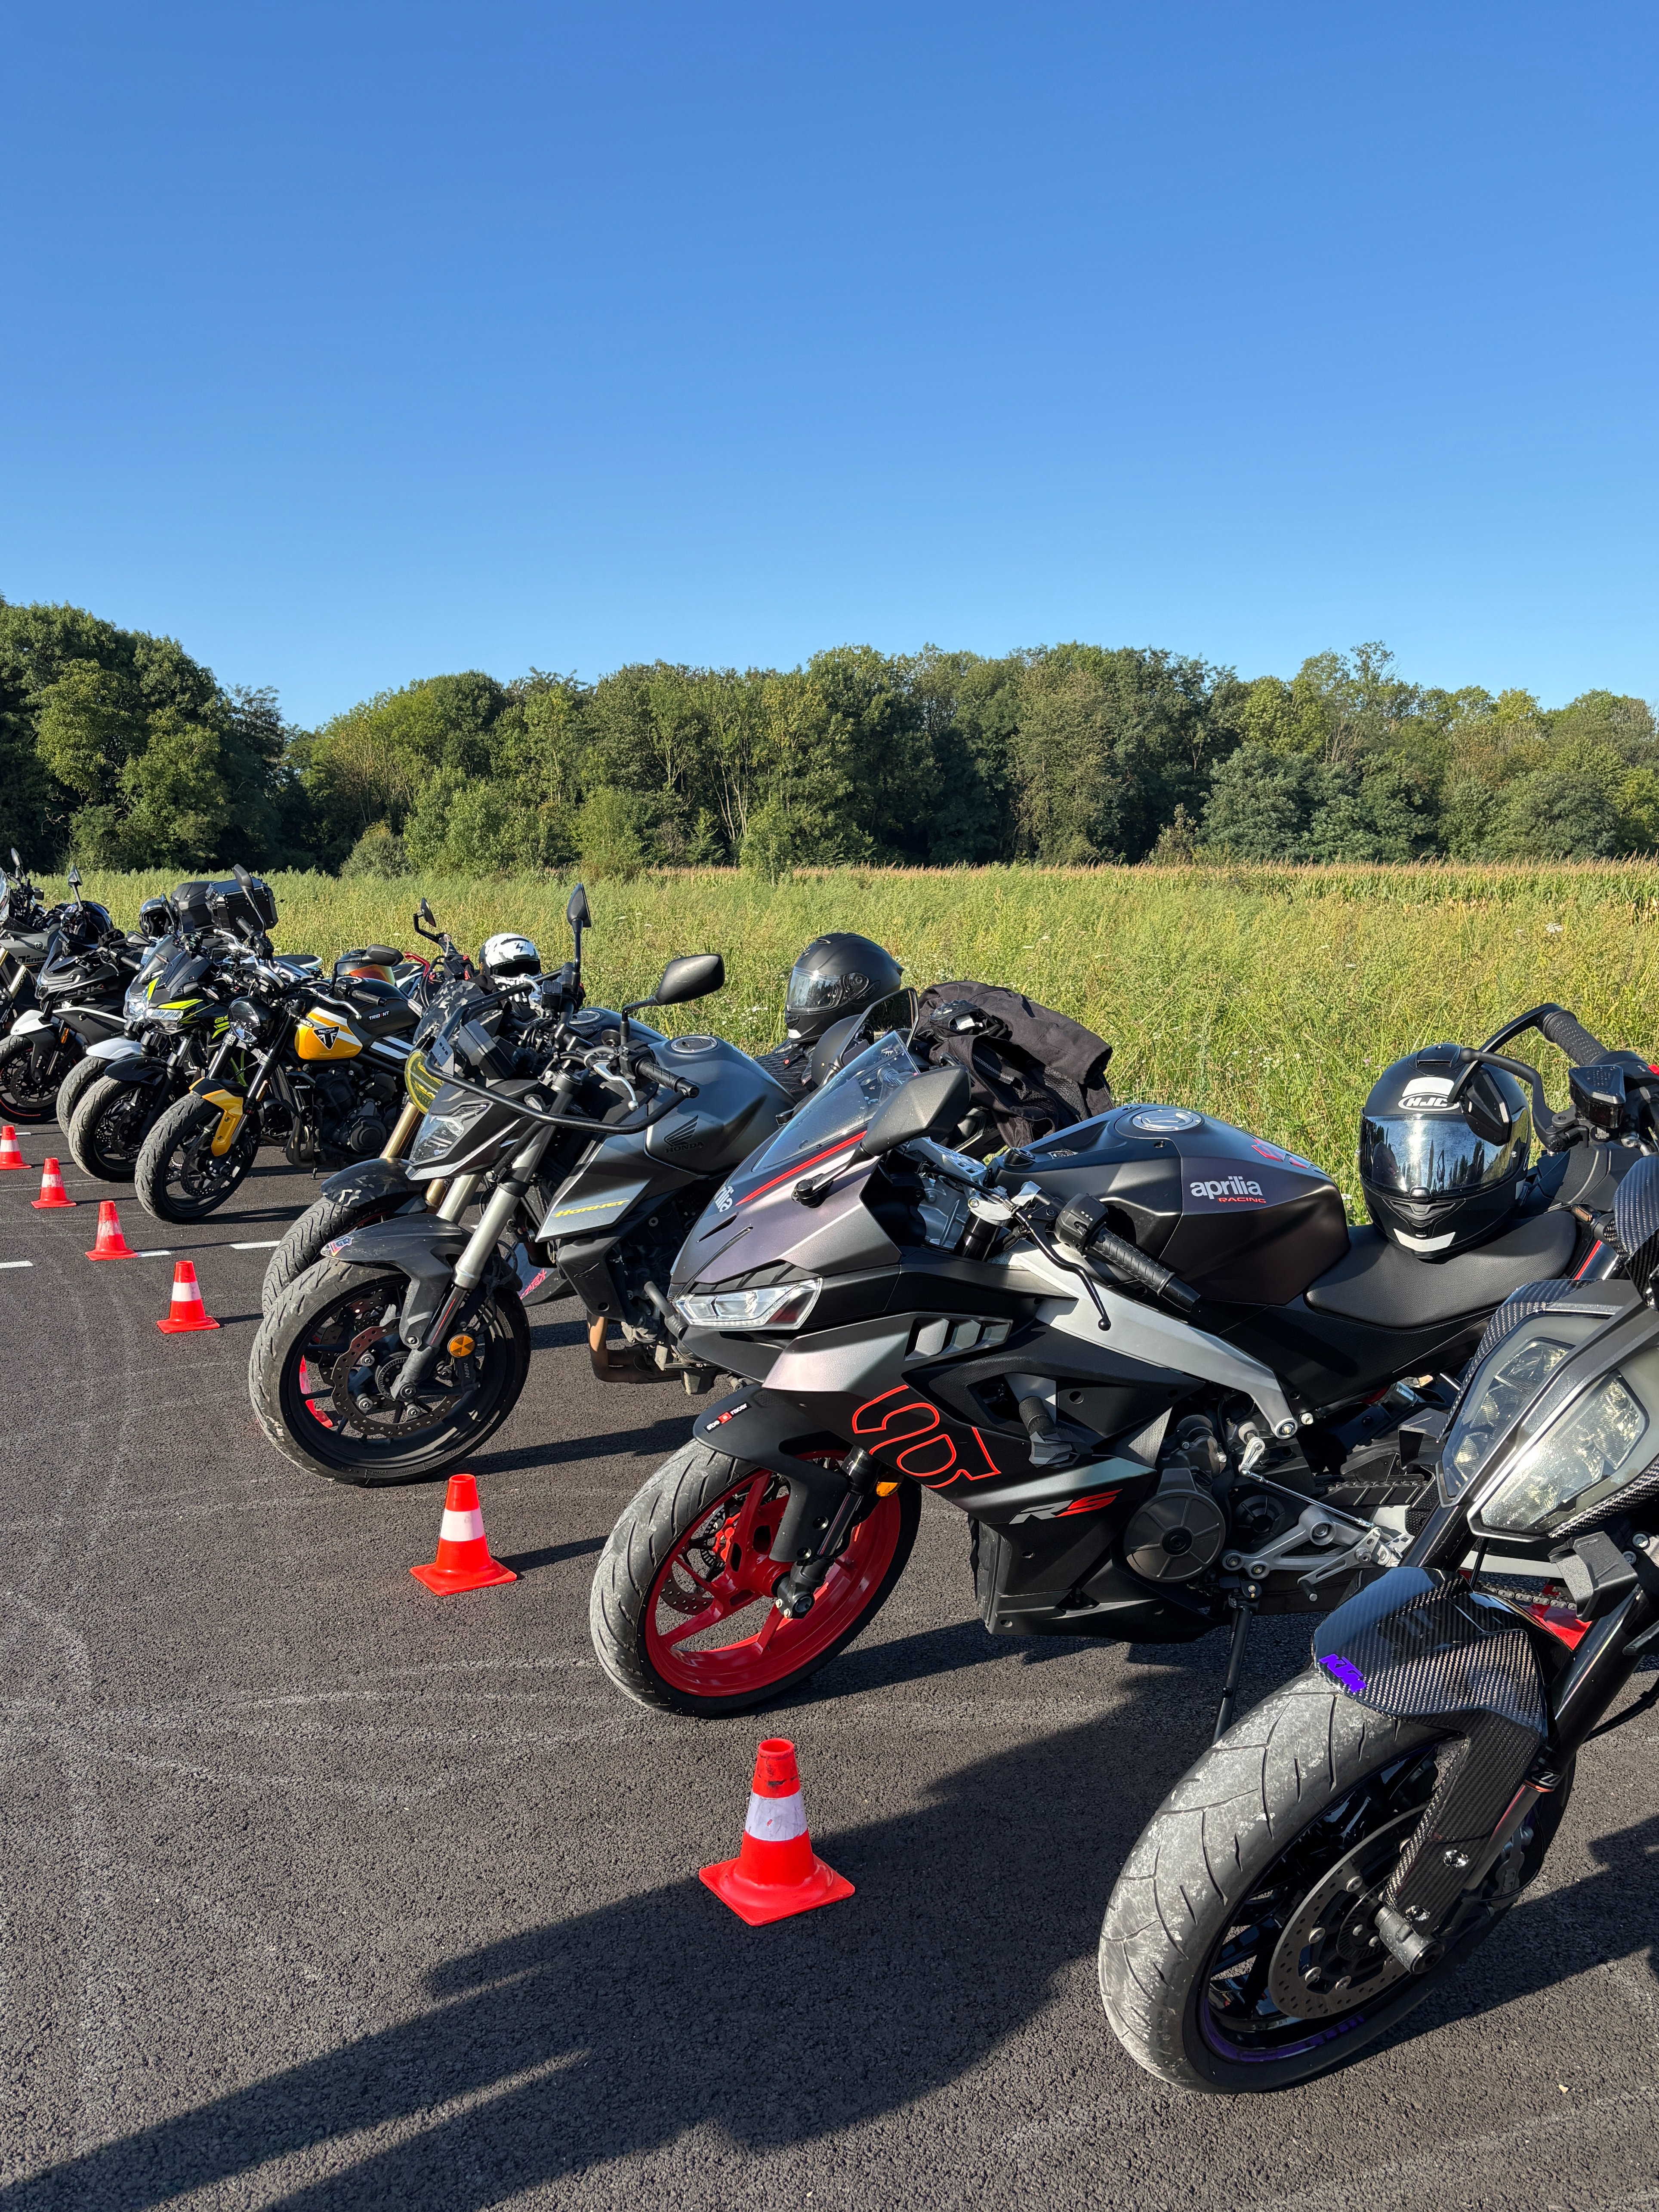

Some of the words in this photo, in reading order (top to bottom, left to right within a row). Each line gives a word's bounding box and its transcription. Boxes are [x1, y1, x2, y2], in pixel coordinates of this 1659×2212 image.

[1406, 1097, 1448, 1108] HJC
[666, 1141, 705, 1154] HONDA
[1190, 1177, 1263, 1200] aprilia
[552, 1198, 629, 1218] HORNET
[730, 1403, 747, 1415] racer
[1008, 1488, 1123, 1525] RS
[1318, 1653, 1367, 1693] KTM
